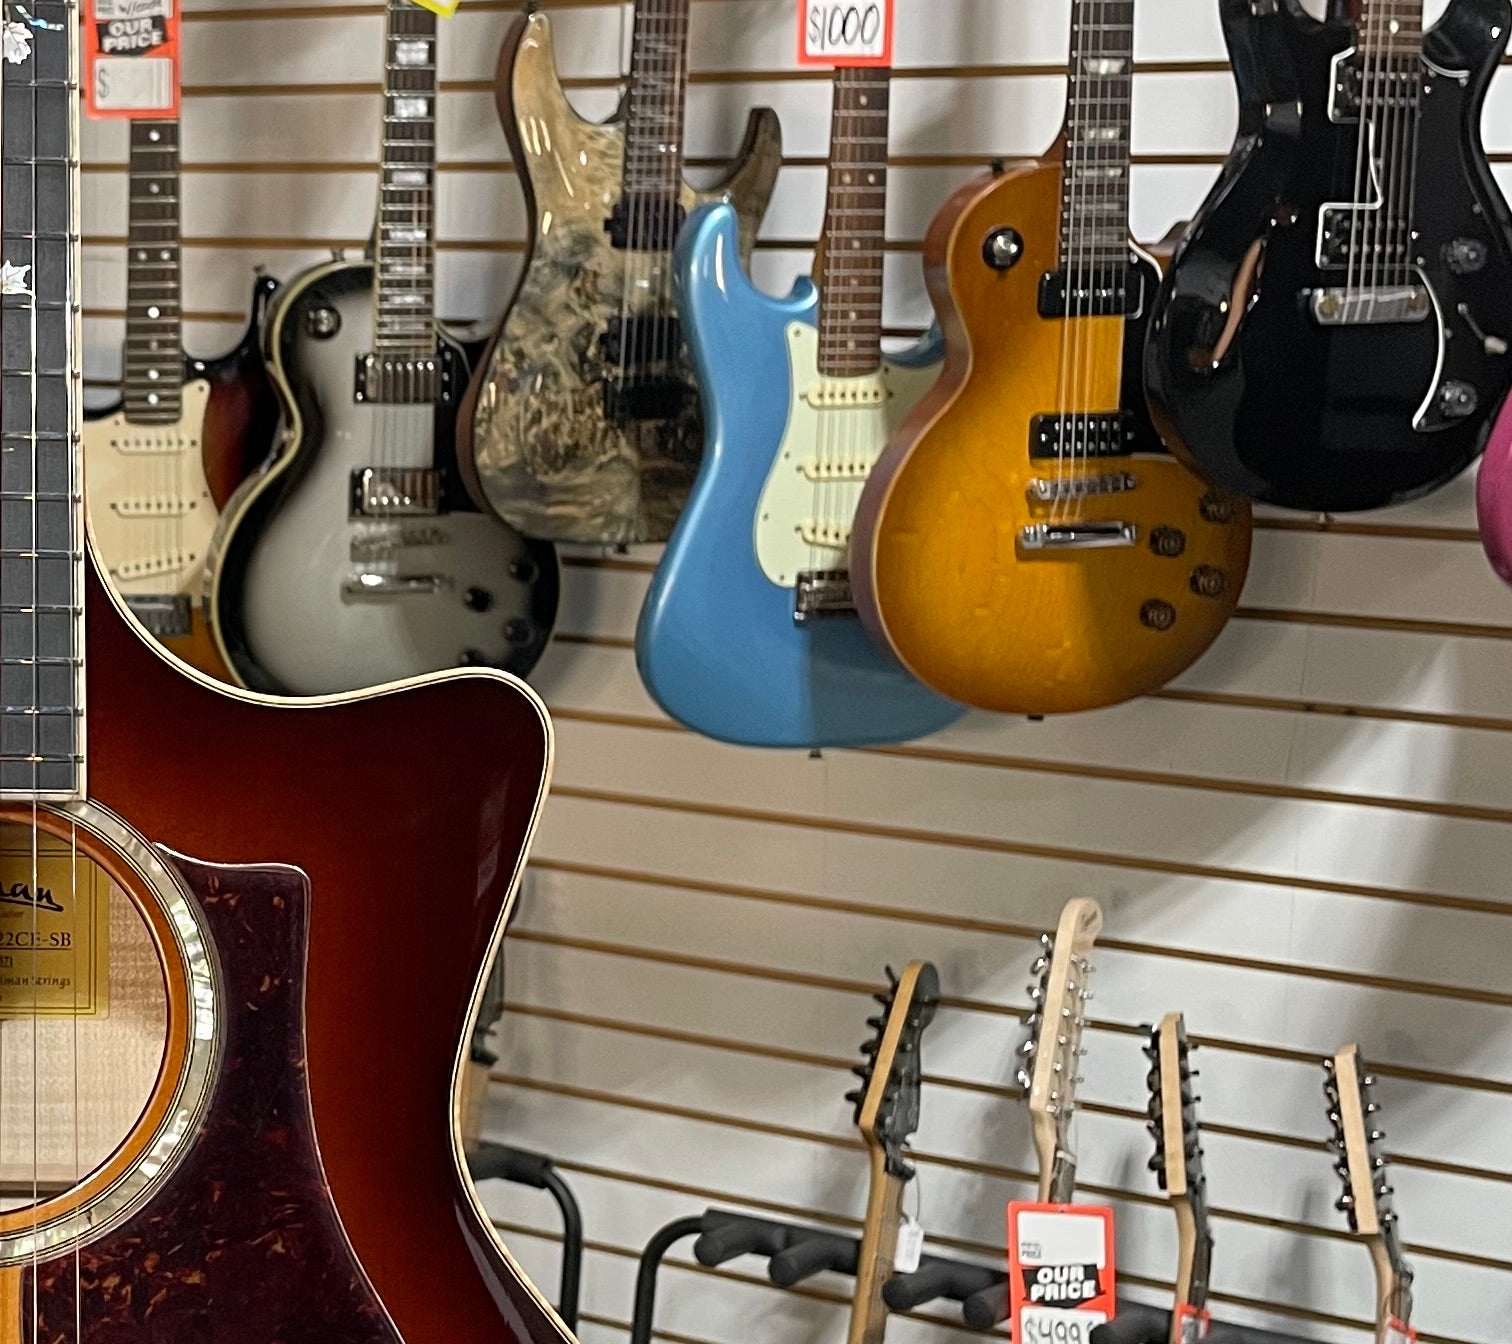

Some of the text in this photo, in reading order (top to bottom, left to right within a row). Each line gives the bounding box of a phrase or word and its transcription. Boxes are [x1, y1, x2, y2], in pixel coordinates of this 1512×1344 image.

[108, 17, 154, 38] OUR
[808, 3, 881, 52] $1000
[102, 31, 165, 54] PRICE
[1036, 1264, 1085, 1285] OUR
[1030, 1279, 1097, 1303] PRICE
